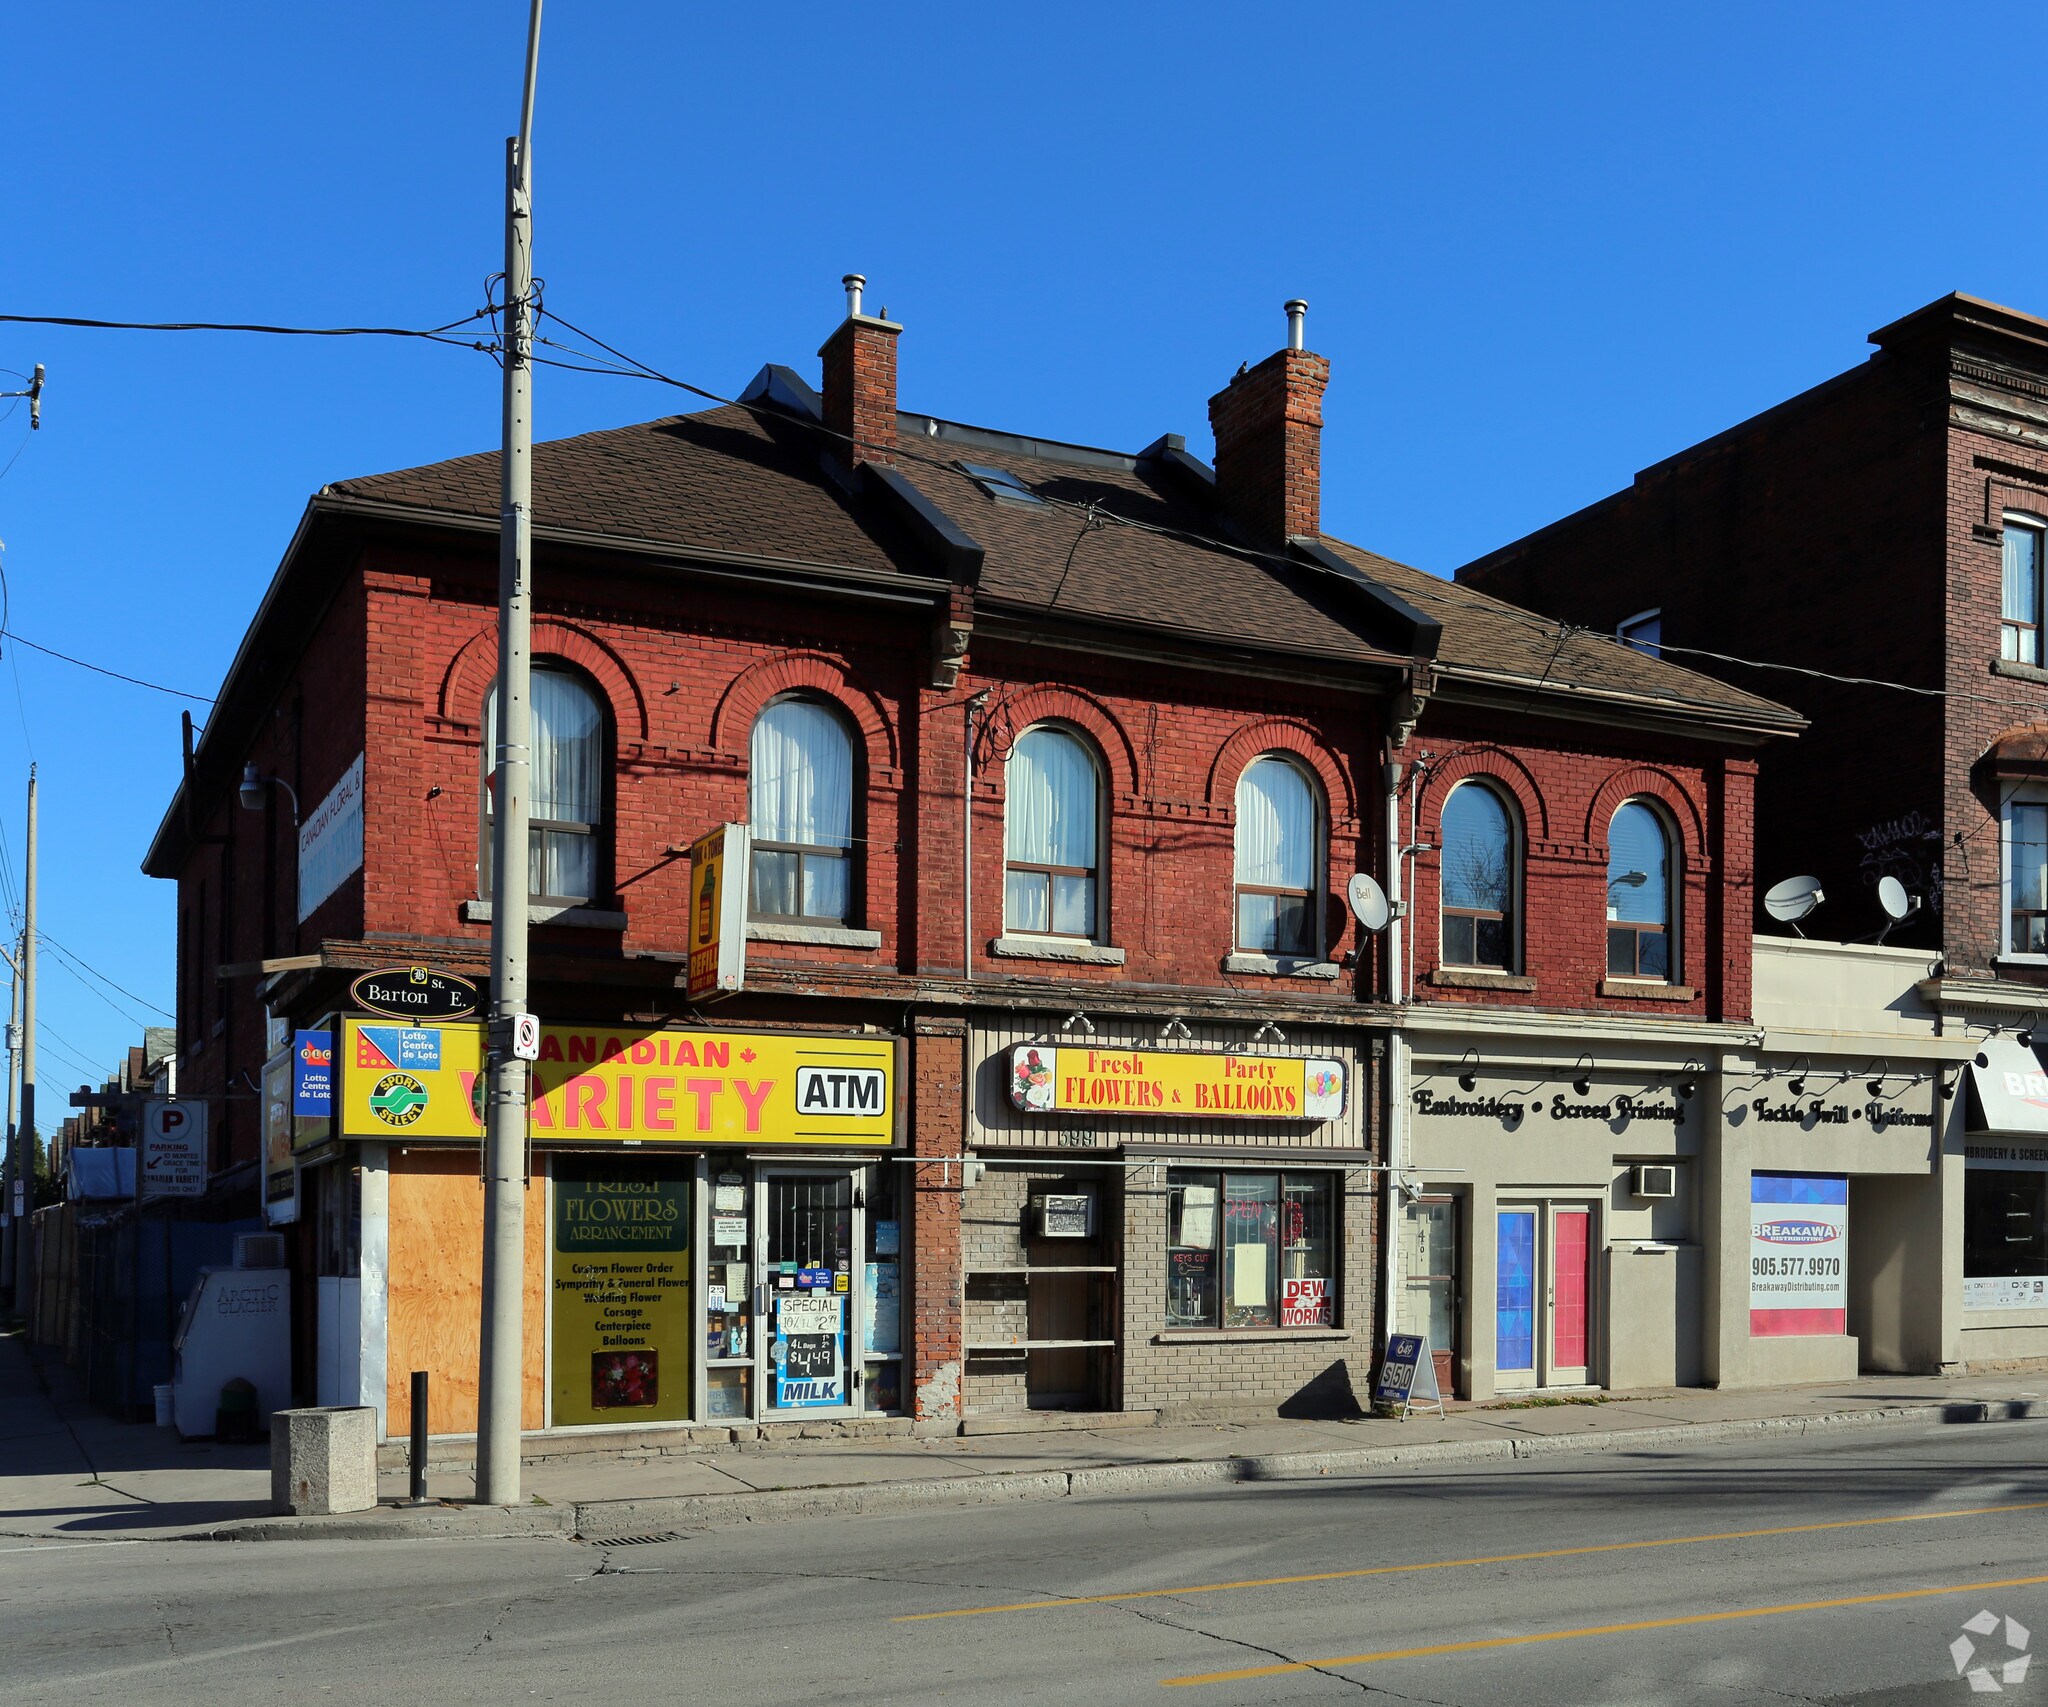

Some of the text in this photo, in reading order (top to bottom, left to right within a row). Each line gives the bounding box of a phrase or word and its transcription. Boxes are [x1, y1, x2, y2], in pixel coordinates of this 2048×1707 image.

[302, 808, 329, 852] CANADIAN
[329, 780, 353, 820] FLORAL
[1356, 887, 1371, 900] Bell
[690, 947, 718, 978] REFILL
[432, 978, 444, 988] St.
[368, 984, 466, 1006] Barton E.
[402, 1031, 426, 1040] Lotto
[402, 1041, 434, 1050] Centre
[537, 1034, 729, 1067] ANADIAN
[402, 1050, 438, 1060] de Loto
[1088, 1051, 1278, 1085] Fresh Party
[305, 1074, 328, 1082] Lotto
[380, 1075, 419, 1091] SPORT
[302, 1082, 330, 1090] Centre
[804, 1071, 878, 1110] ATM
[300, 1090, 310, 1098] de
[1065, 1077, 1296, 1112] FLOWERS & BALLOONS
[1412, 1089, 1684, 1126] Embroidery Screen Printing
[1753, 1097, 1934, 1126] Tackle Twill Uniforms
[163, 1111, 183, 1133] P
[380, 1105, 422, 1126] SELECT
[1059, 1130, 1096, 1147] 399
[2010, 1148, 2016, 1160] &
[143, 1175, 200, 1184] CANADIAN VARIETY
[565, 1199, 678, 1222] FLOWERS
[1225, 1200, 1263, 1219] OPEN
[570, 1226, 672, 1240] ARRANGEMENT
[1752, 1224, 1844, 1238] BREAKAWAY
[1174, 1254, 1210, 1262] KEYS CUT
[572, 1263, 673, 1274] Custom Flower Order
[872, 1265, 892, 1274] NOW
[1752, 1258, 1840, 1276] 905.577.9970
[556, 1278, 604, 1290] Sympathy
[608, 1279, 614, 1288] &
[618, 1278, 654, 1288] Funeral
[1288, 1280, 1328, 1297] DEW
[1752, 1282, 1840, 1292] BreakawayDistributing.com
[218, 1284, 278, 1302] ARCTIC
[584, 1292, 662, 1304] Wedding Flower
[218, 1301, 278, 1315] GLACIER
[604, 1308, 642, 1318] Corsage
[784, 1300, 837, 1312] SPECIAL
[1283, 1308, 1331, 1326] WORMS
[595, 1321, 651, 1332] Centerpiece
[603, 1335, 645, 1346] Balloons
[803, 1342, 816, 1350] Bags
[784, 1382, 837, 1400] MILK
